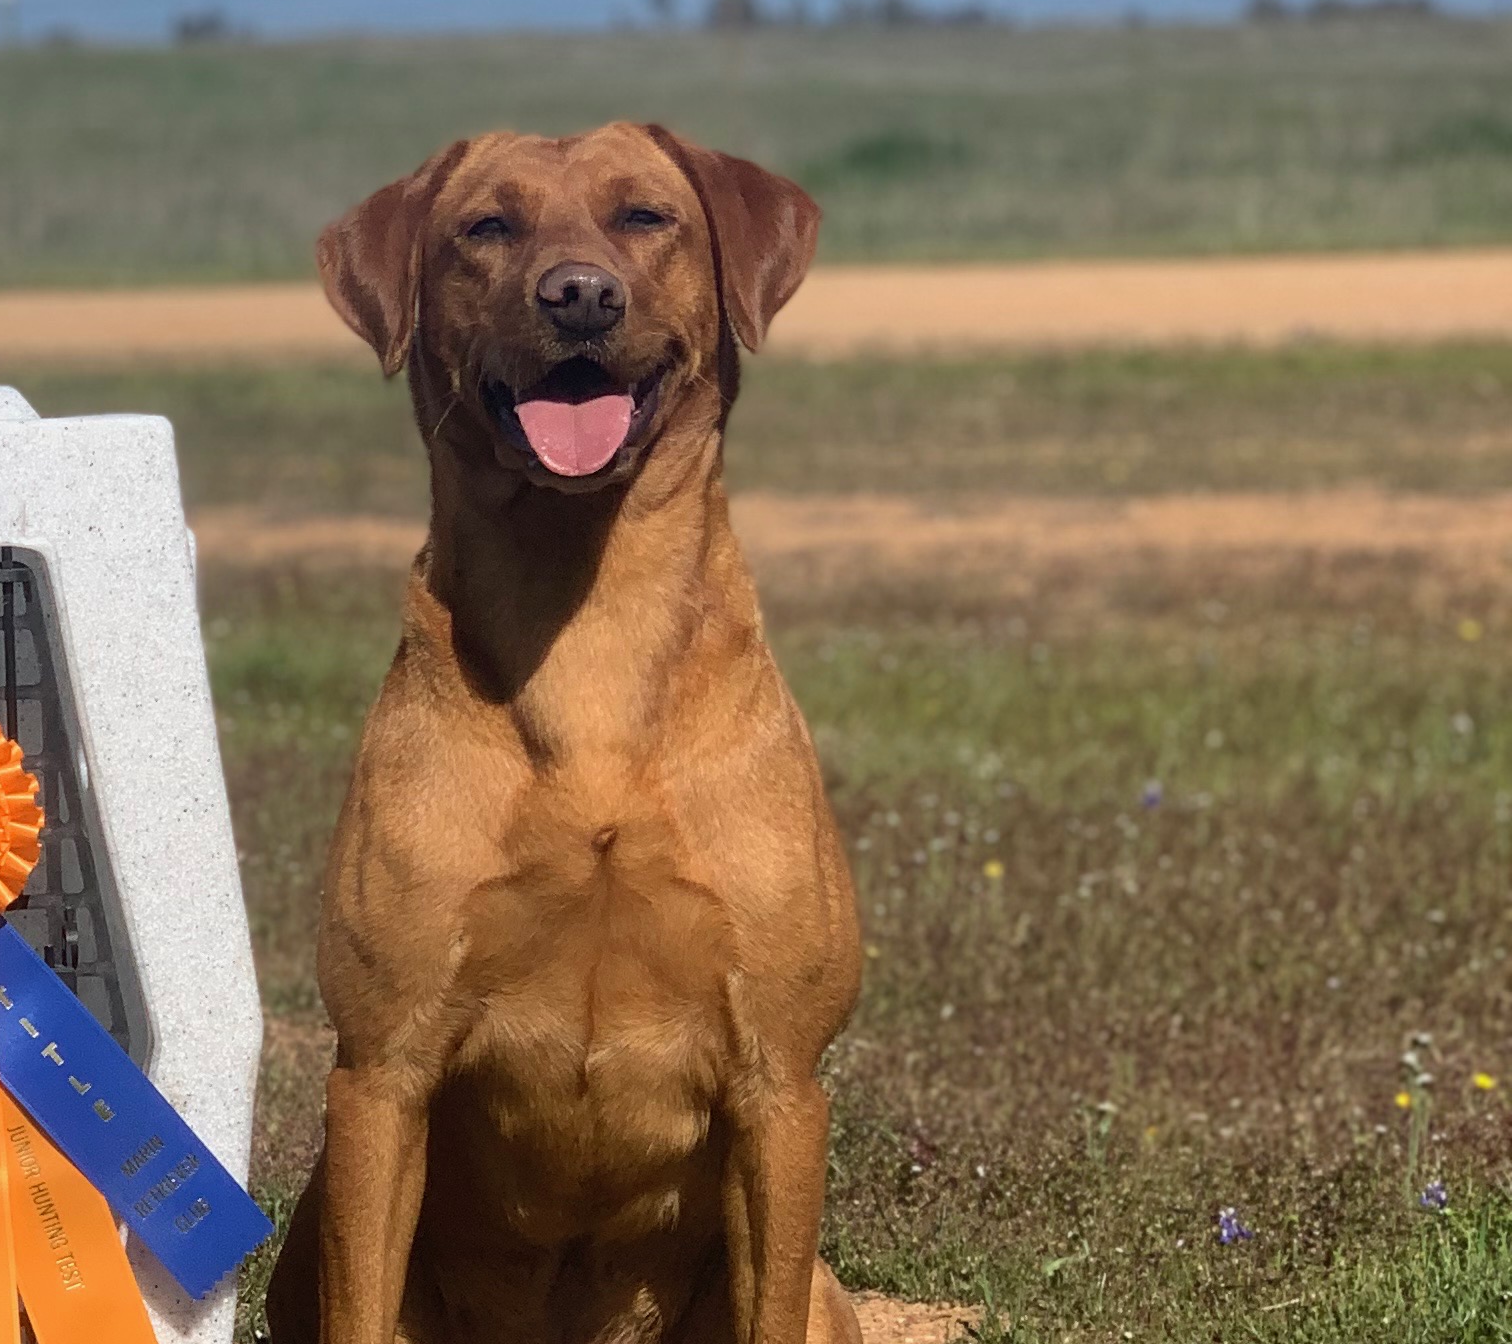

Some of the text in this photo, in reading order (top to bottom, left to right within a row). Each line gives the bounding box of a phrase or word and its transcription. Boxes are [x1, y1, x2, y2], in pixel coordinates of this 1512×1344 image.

[7, 1125, 86, 1291] JUNIOR HUNTING TEST
[119, 1134, 165, 1178] MARIN
